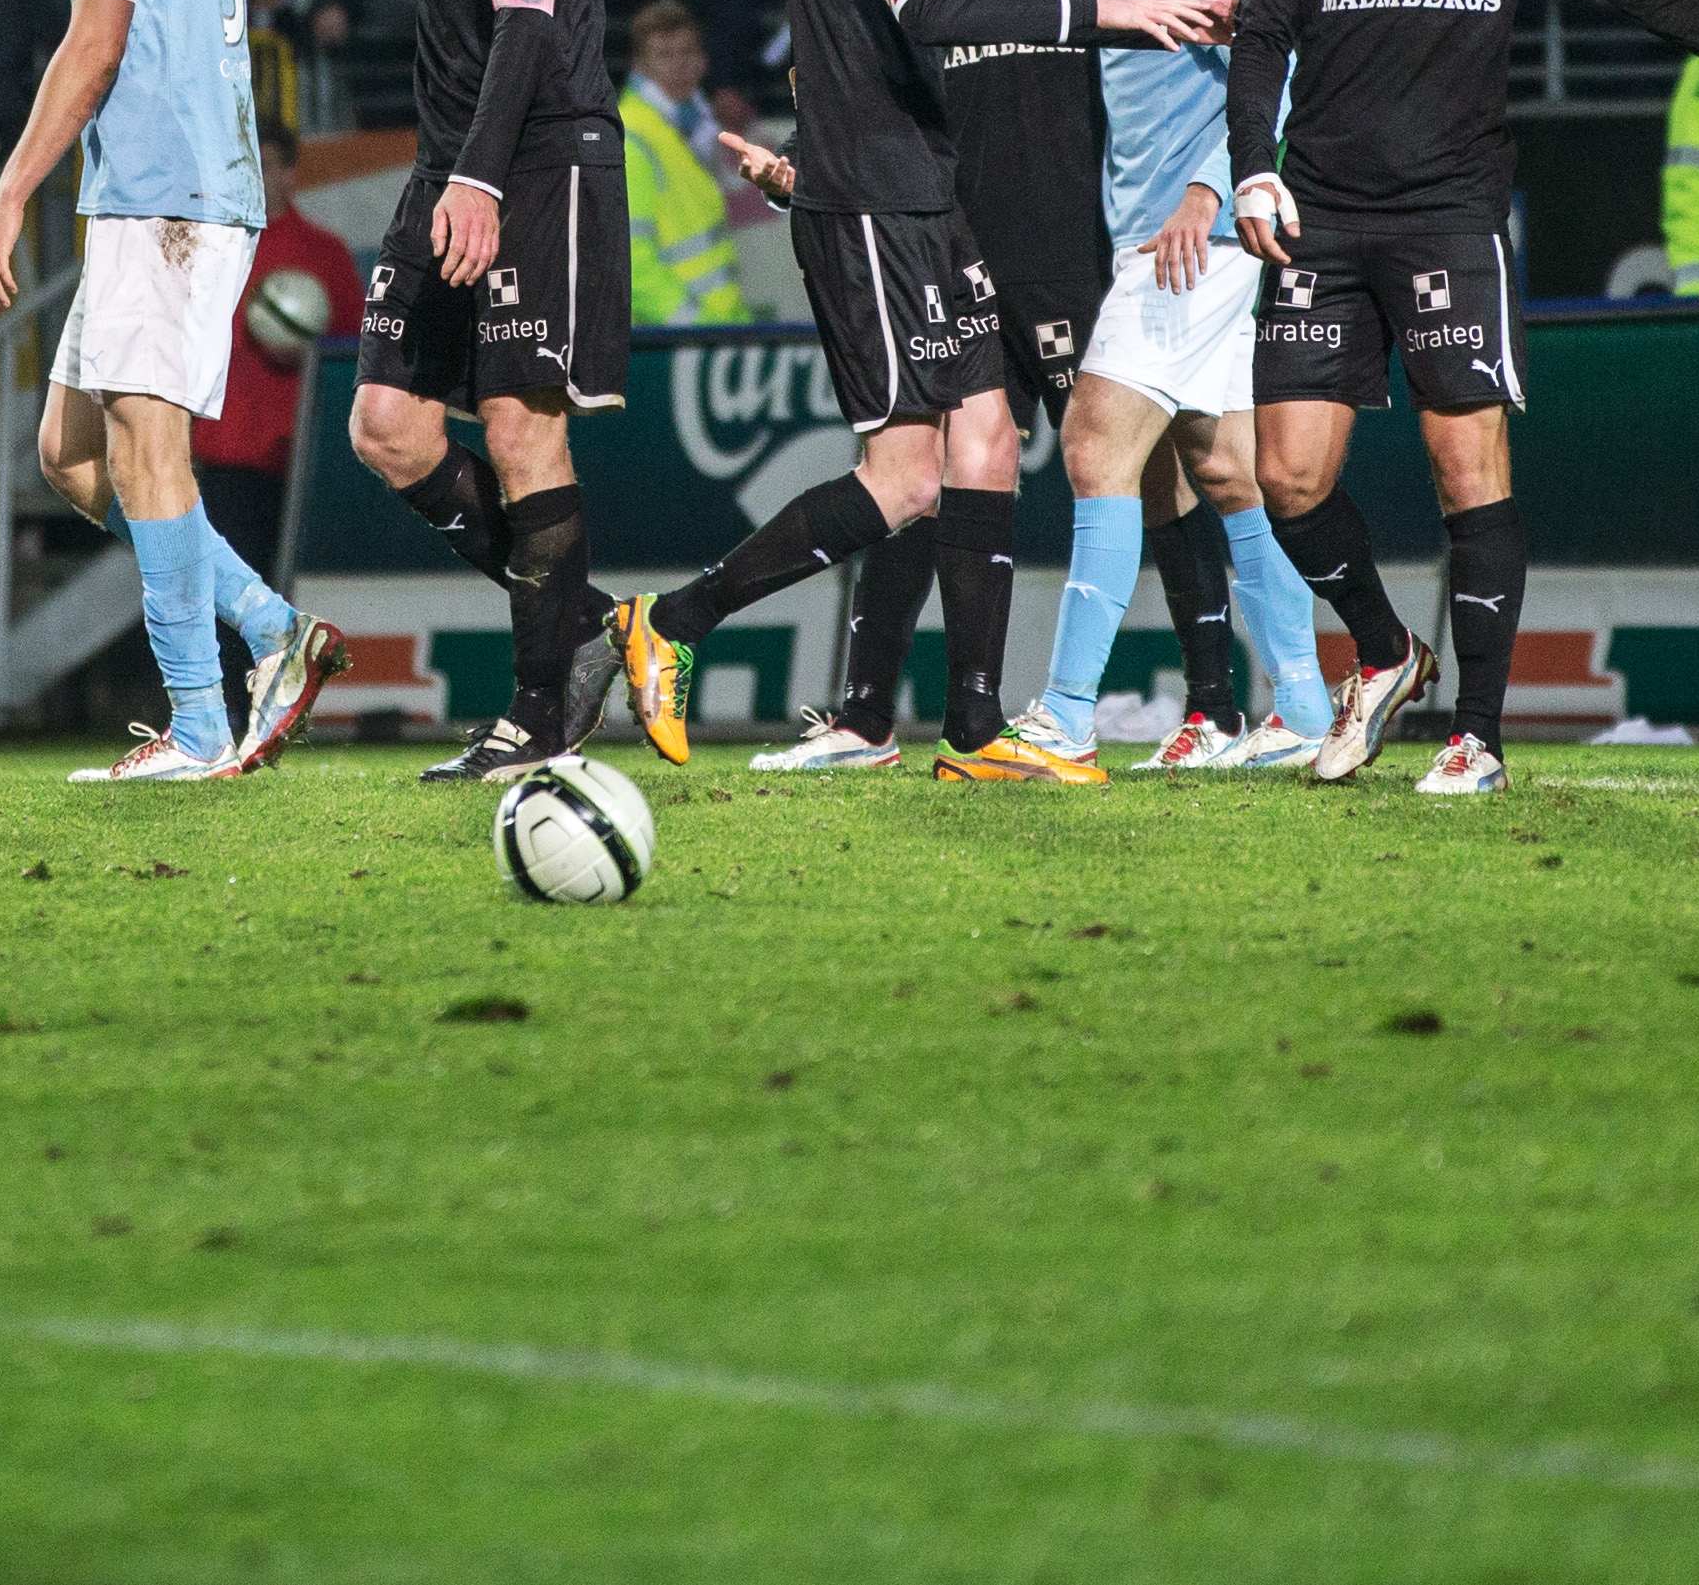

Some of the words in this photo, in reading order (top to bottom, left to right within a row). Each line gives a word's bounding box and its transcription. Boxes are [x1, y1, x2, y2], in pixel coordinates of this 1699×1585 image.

[477, 318, 548, 344] Strateg
[1256, 319, 1342, 348] Strateg
[1406, 324, 1485, 353] Strateg
